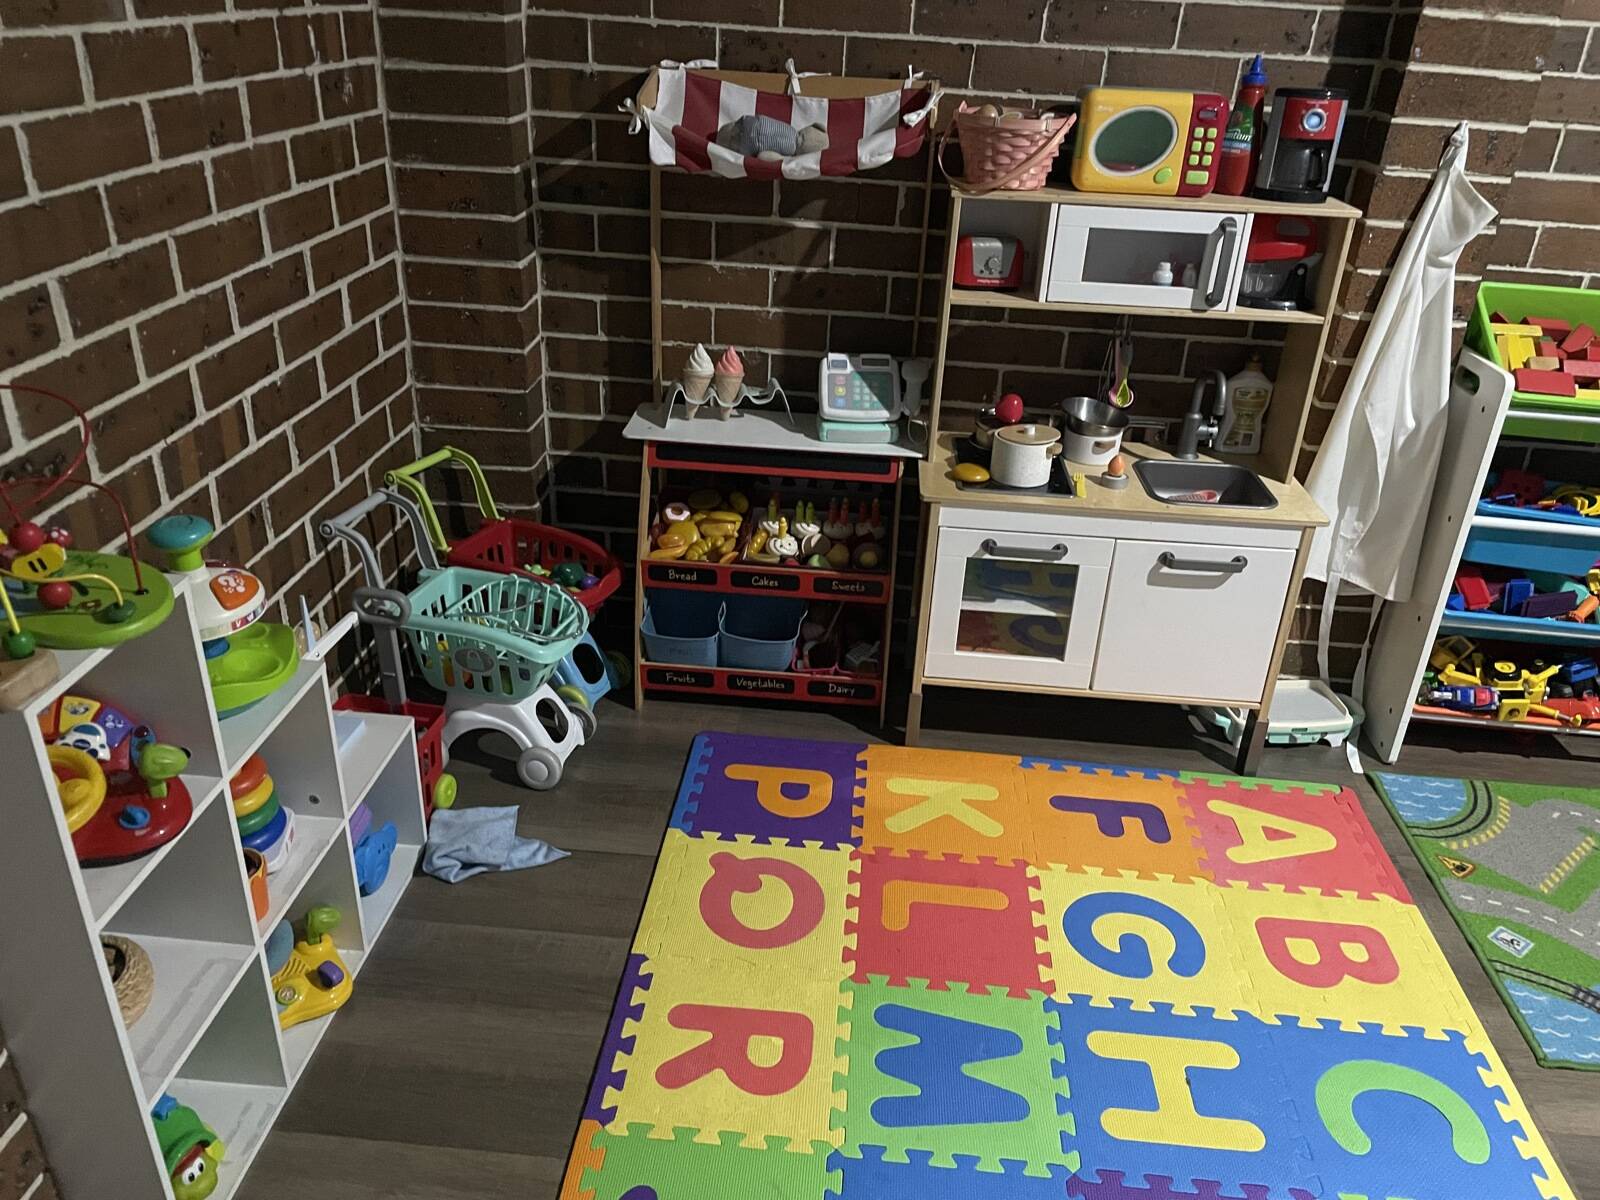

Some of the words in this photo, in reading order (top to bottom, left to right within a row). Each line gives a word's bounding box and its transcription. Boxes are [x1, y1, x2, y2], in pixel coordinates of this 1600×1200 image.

[668, 568, 698, 581] Bread
[751, 575, 780, 587] Cakes
[831, 580, 866, 593] Sweets
[665, 671, 696, 684] Fruits
[736, 677, 786, 690] Vegetables
[828, 683, 855, 697] Dairy
[724, 763, 833, 818] P
[884, 777, 1004, 838] K
[1048, 794, 1172, 844] F
[1206, 799, 1337, 864] A
[699, 851, 826, 949] Q
[881, 880, 1010, 931] L
[1062, 891, 1206, 979] G
[1254, 916, 1400, 988] B
[654, 1003, 814, 1096] R
[870, 1003, 1031, 1129] M
[1086, 1030, 1266, 1152] H
[1315, 1059, 1491, 1165] C
